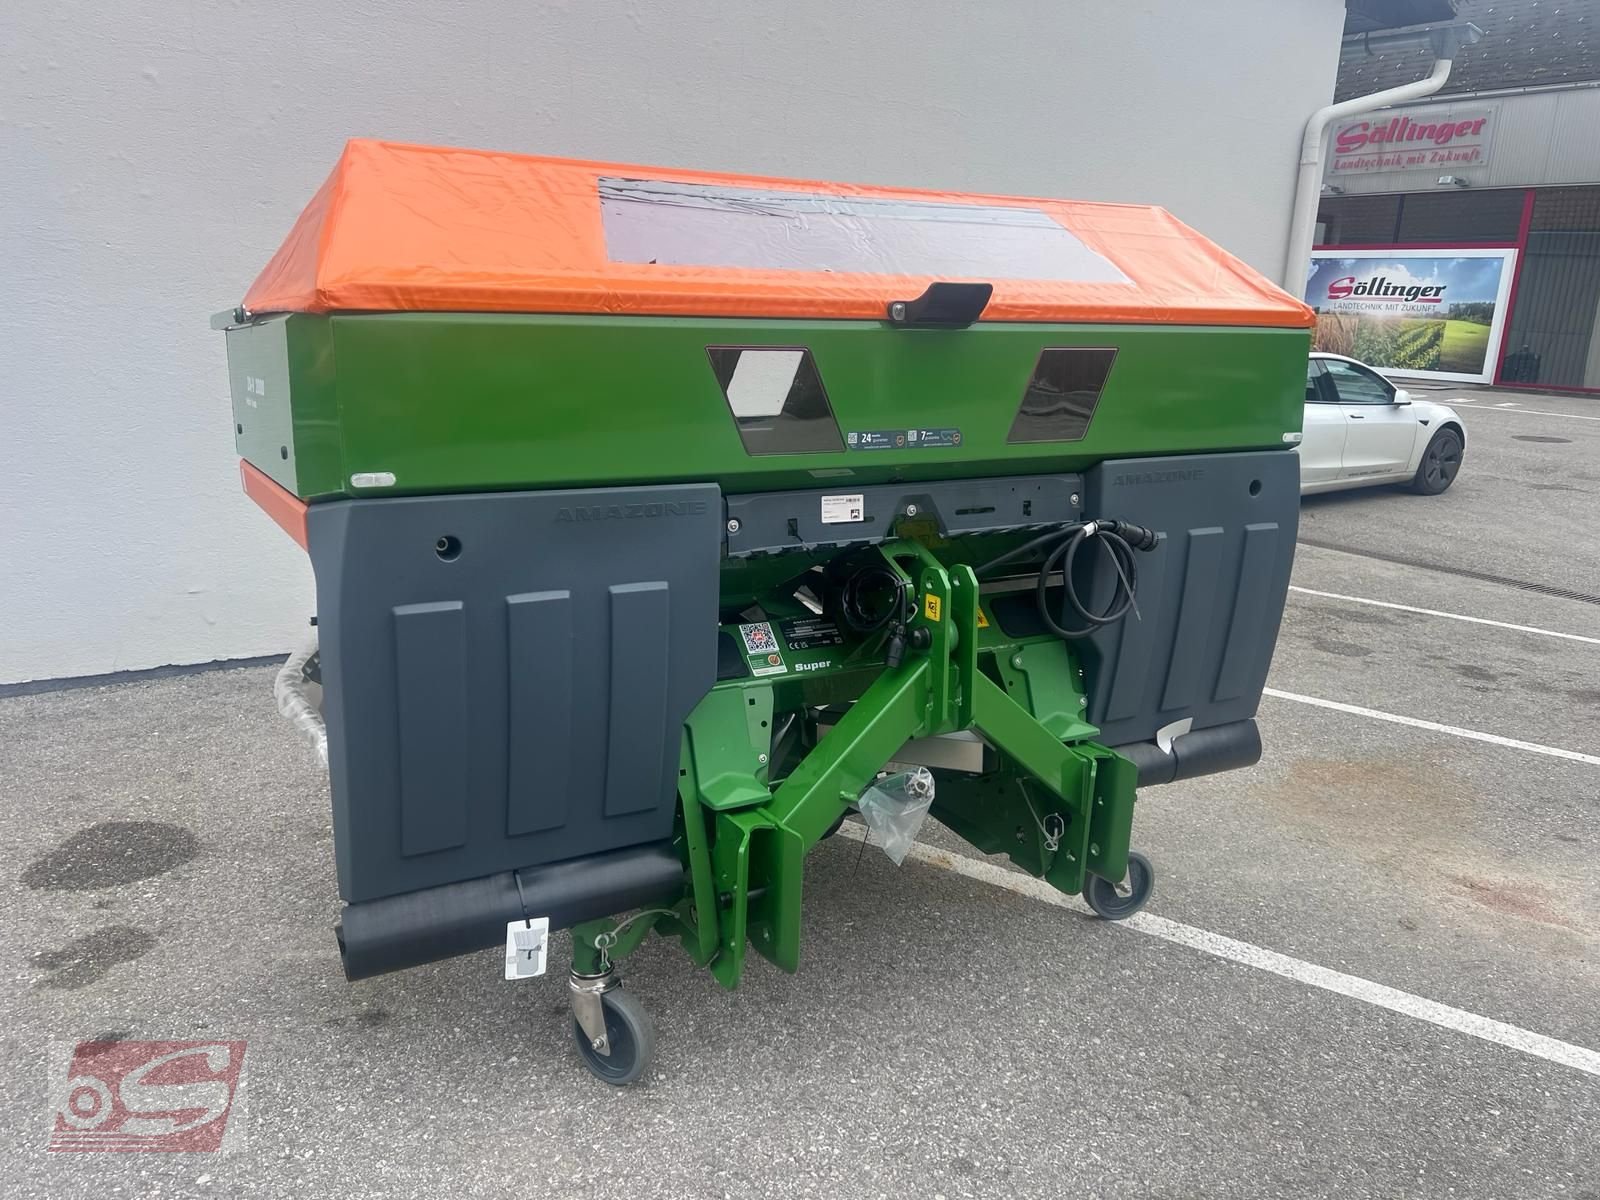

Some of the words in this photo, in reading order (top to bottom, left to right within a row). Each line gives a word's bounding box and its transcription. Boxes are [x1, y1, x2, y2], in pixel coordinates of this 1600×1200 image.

[1335, 116, 1487, 153] Söllinger
[1334, 154, 1402, 170] Landtechnik
[1406, 152, 1426, 165] mit
[1430, 148, 1481, 162] Zukunft
[1327, 276, 1447, 302] Söllinger
[1333, 302, 1383, 311] LANDTECHNIK
[1385, 303, 1399, 311] MIT
[1400, 304, 1437, 312] ZUKUNFT
[861, 433, 872, 443] 24
[553, 501, 706, 523] AMAZONE
[795, 660, 831, 672] Super
